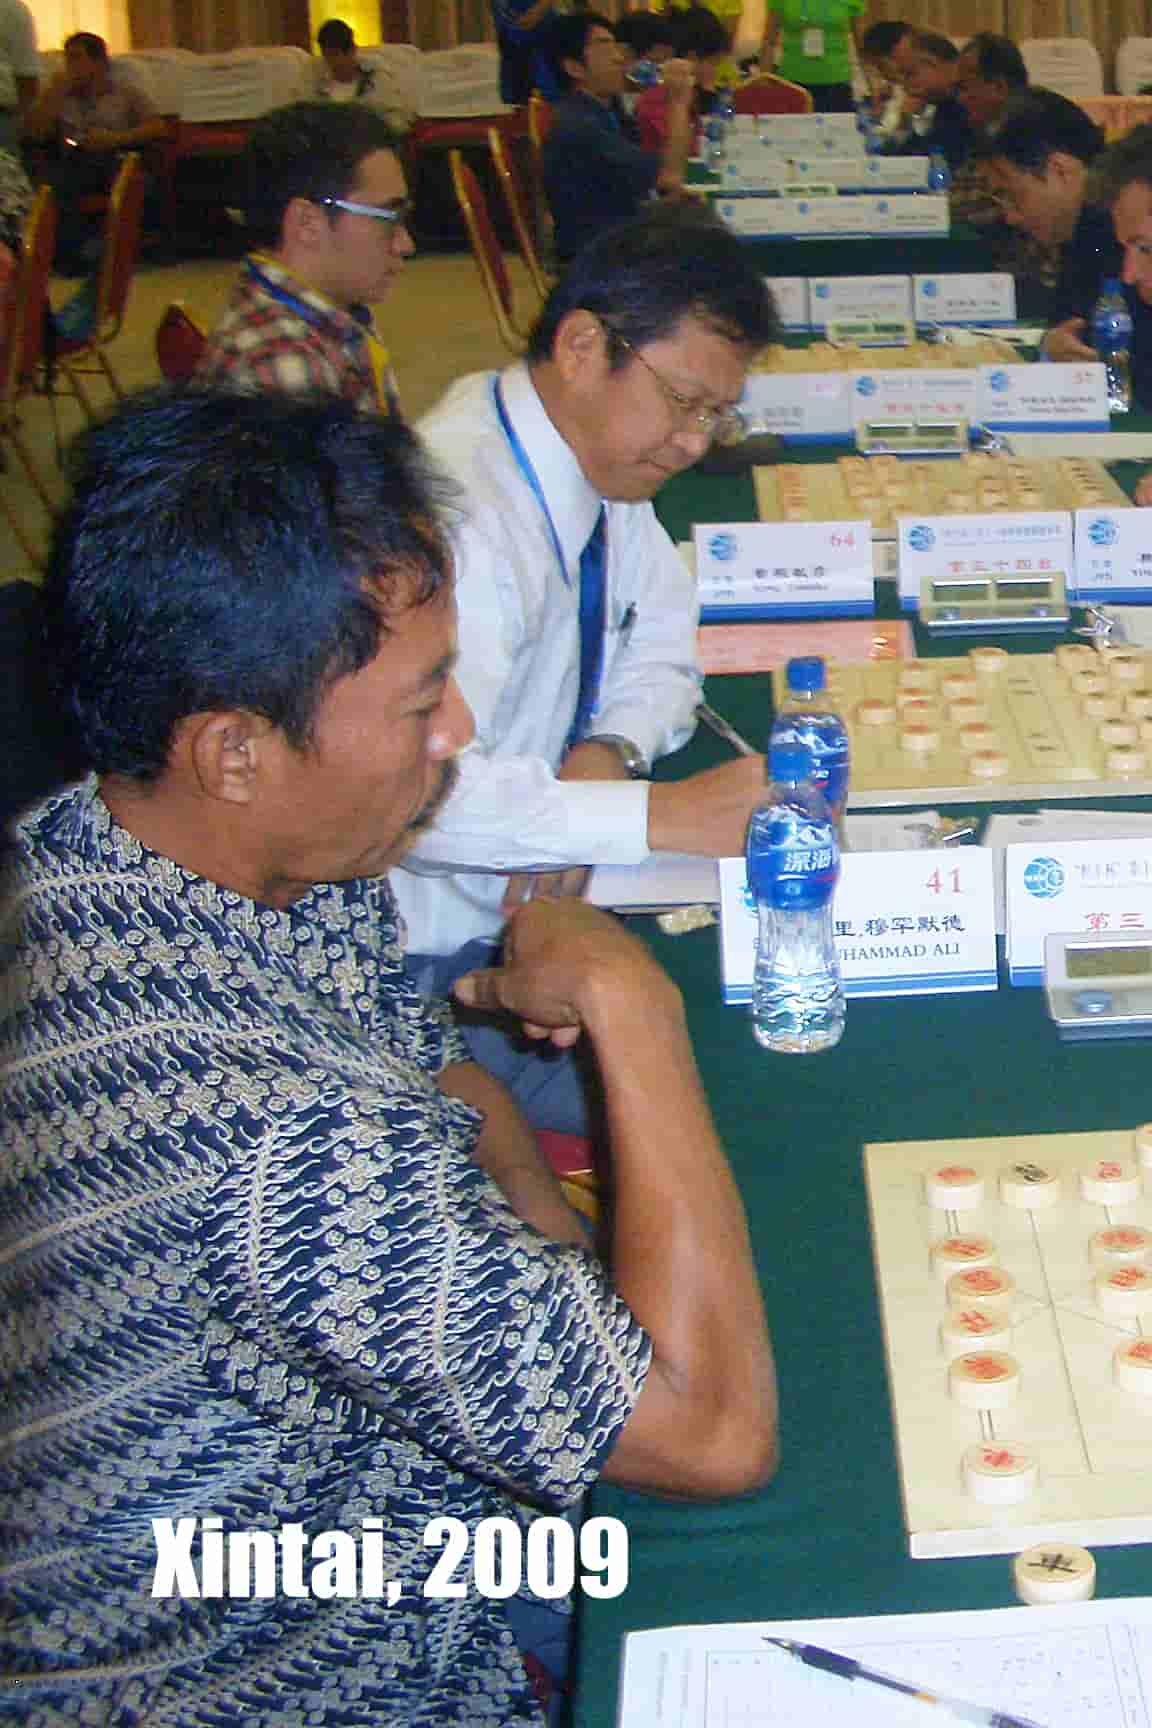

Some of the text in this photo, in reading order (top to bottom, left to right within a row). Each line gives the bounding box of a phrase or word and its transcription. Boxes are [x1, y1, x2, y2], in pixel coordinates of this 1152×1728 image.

[925, 866, 964, 895] 41
[832, 914, 967, 939] 里.穆罕默德
[933, 942, 961, 958] ALI
